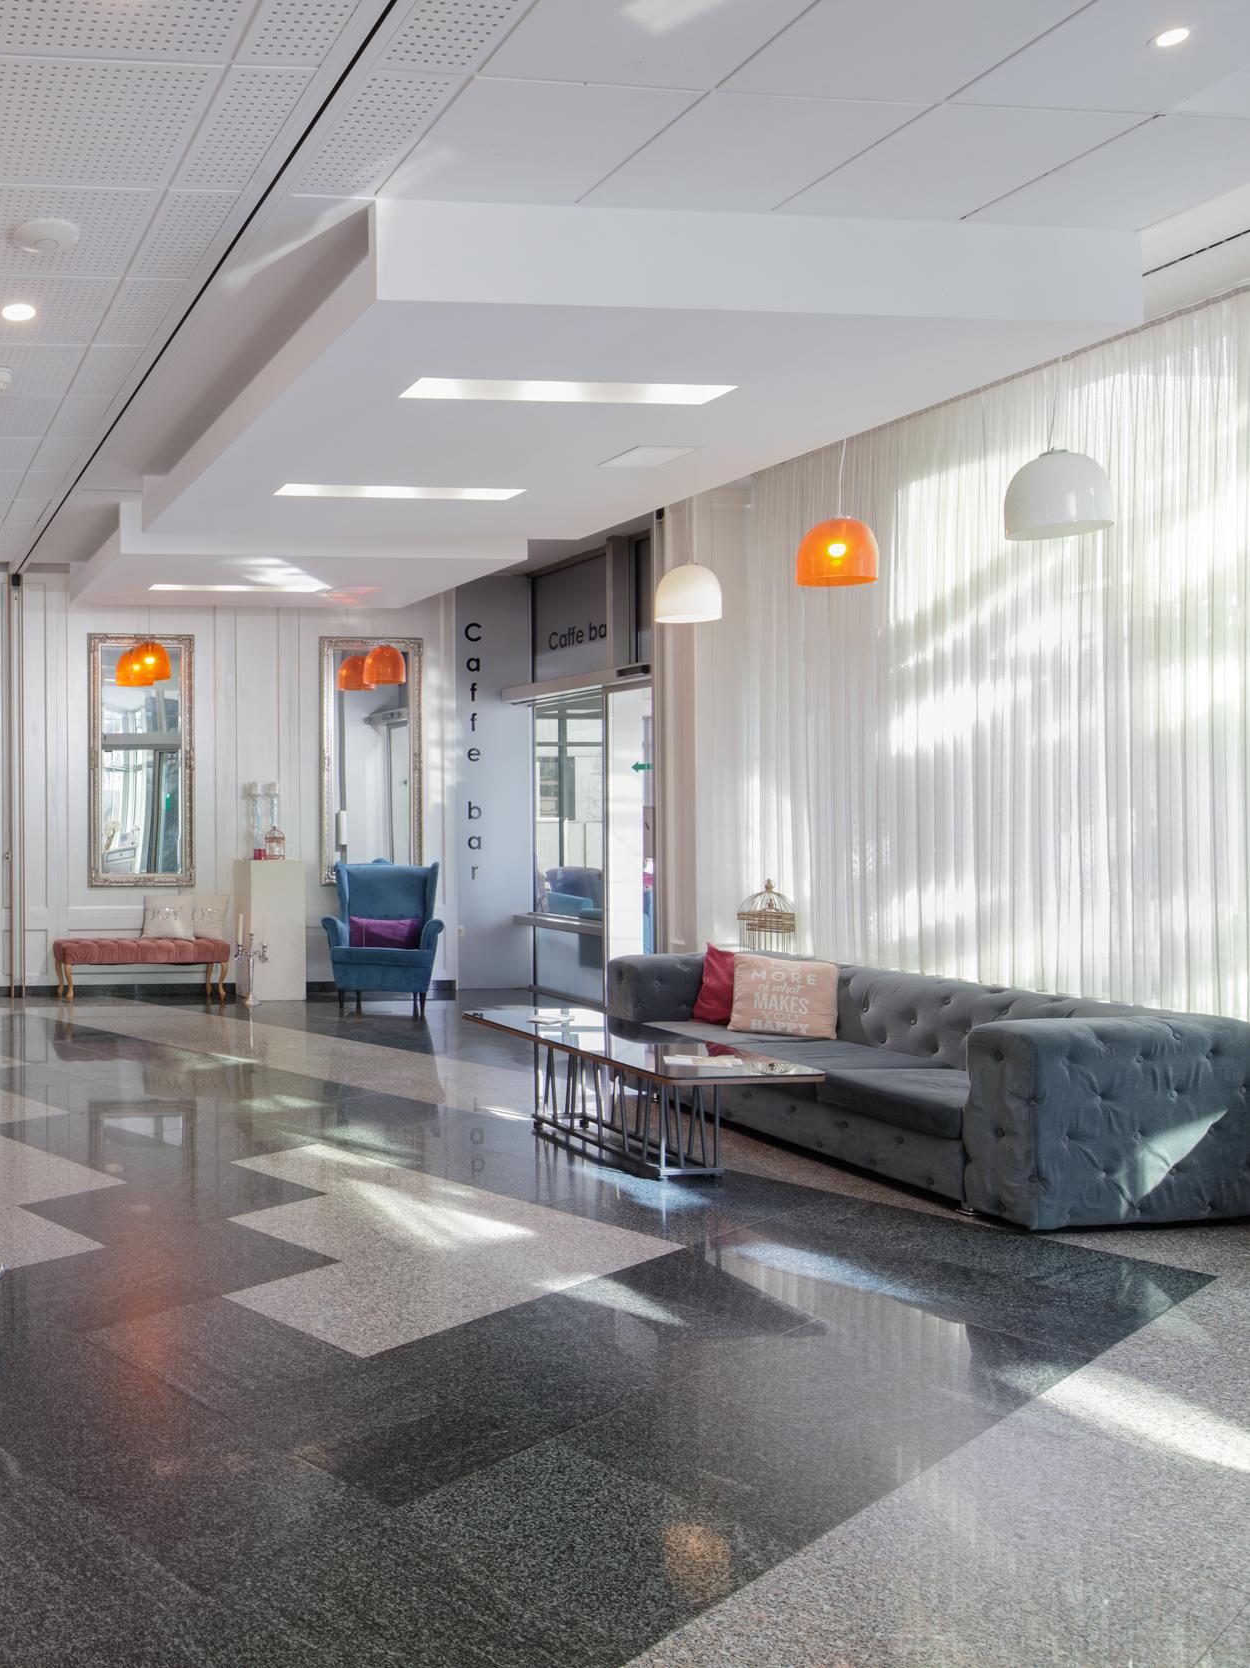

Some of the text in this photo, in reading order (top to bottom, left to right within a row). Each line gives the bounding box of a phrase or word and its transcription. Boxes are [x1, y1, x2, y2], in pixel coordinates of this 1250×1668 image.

[548, 621, 607, 650] Caffe ba
[464, 622, 483, 880] Caffe bar
[191, 906, 219, 921] OY
[750, 969, 818, 986] MORE
[771, 982, 803, 994] what
[753, 992, 809, 1015] MAKES
[759, 1010, 799, 1021] YOU
[750, 1018, 811, 1034] HAPPY
